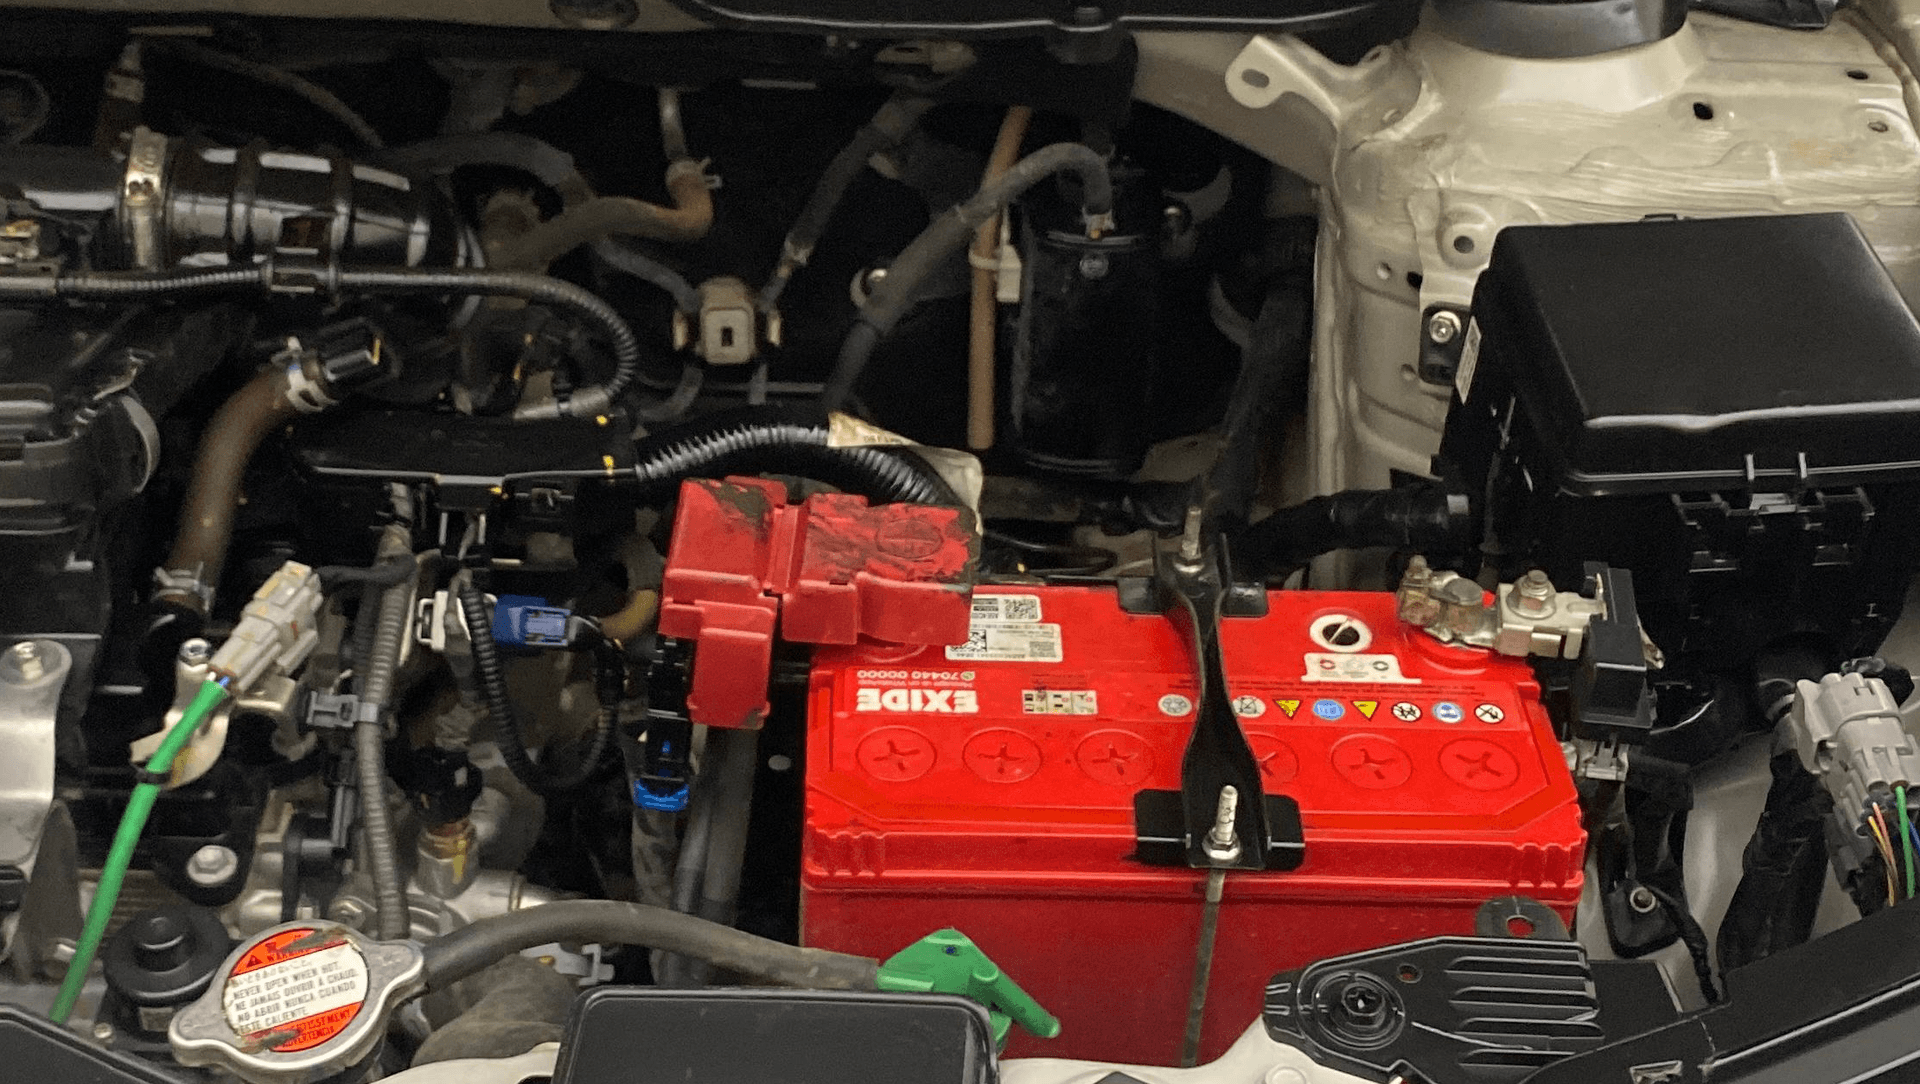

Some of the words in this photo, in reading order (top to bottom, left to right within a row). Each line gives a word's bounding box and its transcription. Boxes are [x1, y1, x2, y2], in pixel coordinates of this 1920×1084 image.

[857, 670, 908, 679] 00000
[856, 687, 979, 713] EXIDE
[233, 985, 260, 1000] NEVER
[265, 976, 289, 991] OPEN
[292, 968, 318, 983] WHEN
[285, 993, 314, 1008] NUNCA
[318, 980, 356, 999] CUANDO
[235, 1001, 247, 1012] NE
[250, 990, 281, 1008] JAMAIS
